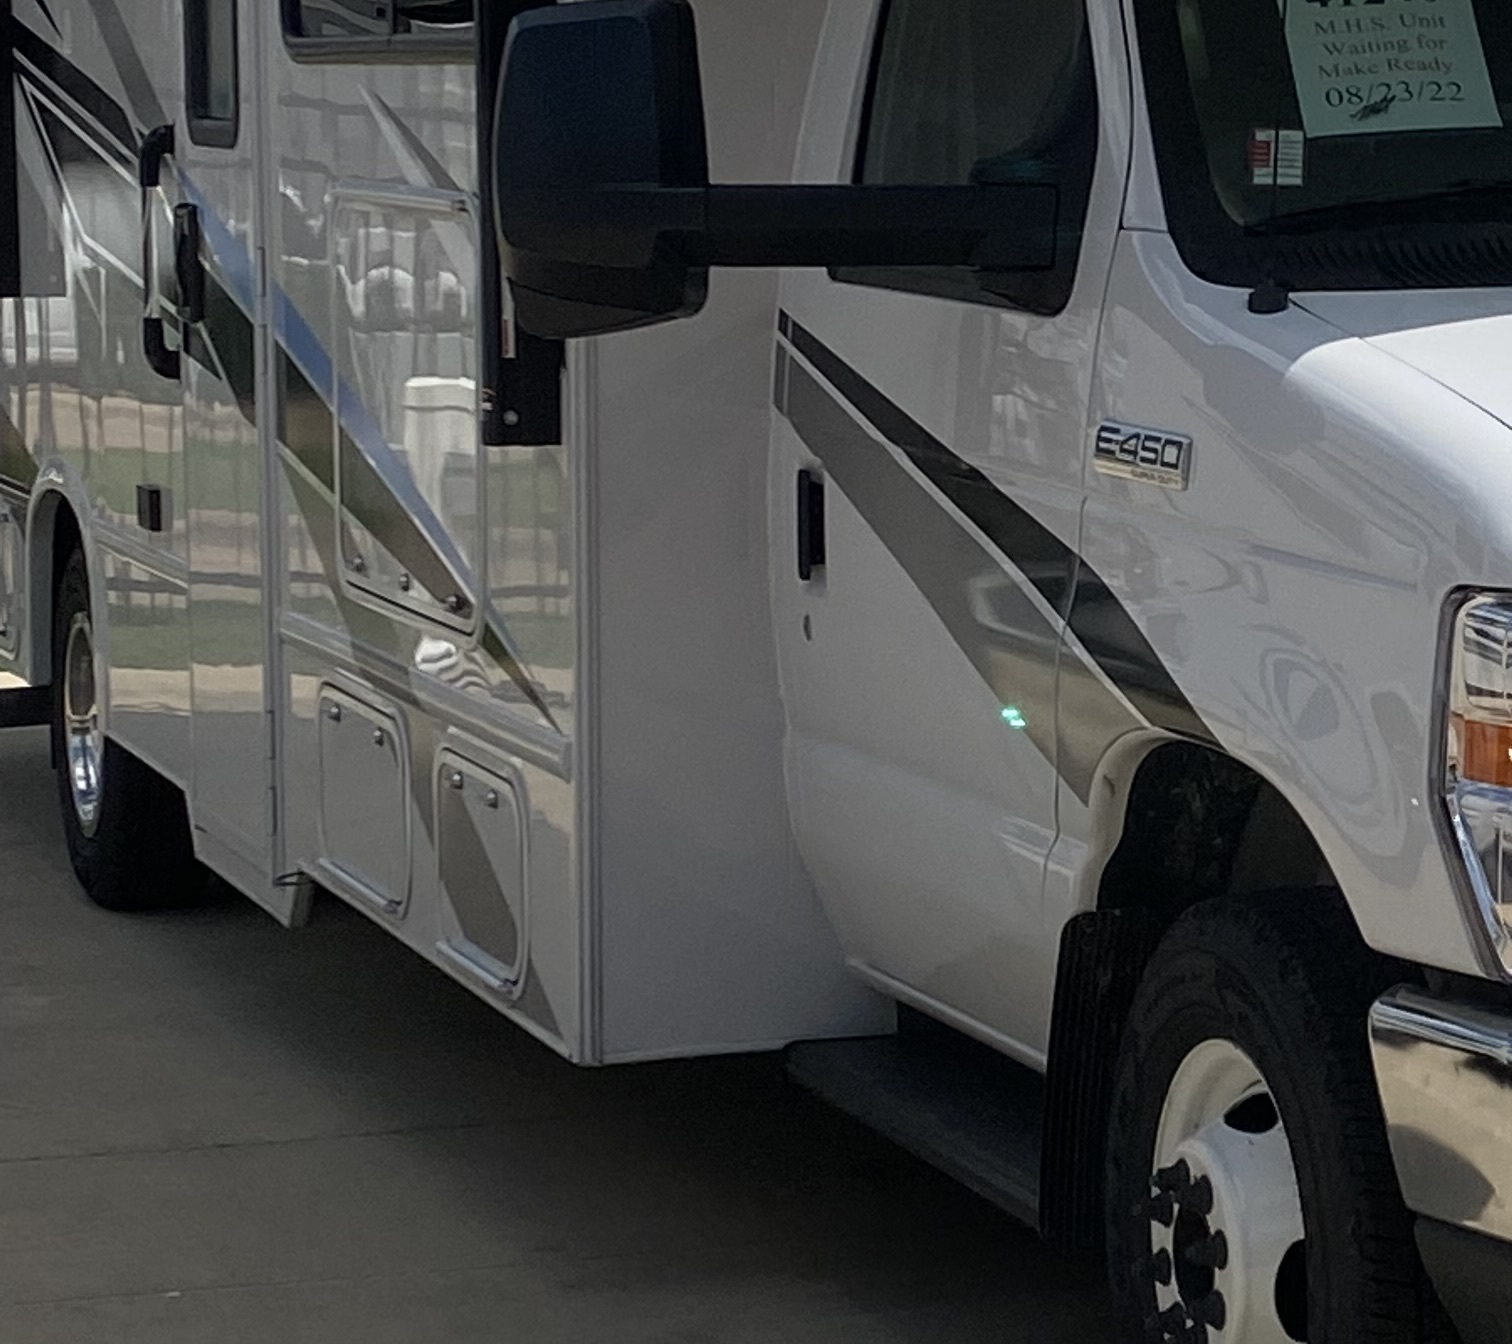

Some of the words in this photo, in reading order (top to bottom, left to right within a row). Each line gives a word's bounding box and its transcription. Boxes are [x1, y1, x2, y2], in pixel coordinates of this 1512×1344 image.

[1399, 13, 1447, 29] Unit
[1322, 37, 1411, 57] Waiting
[1417, 35, 1449, 51] for
[1318, 62, 1381, 79] Make
[1387, 57, 1453, 76] Ready
[1325, 81, 1466, 108] 08/23/22
